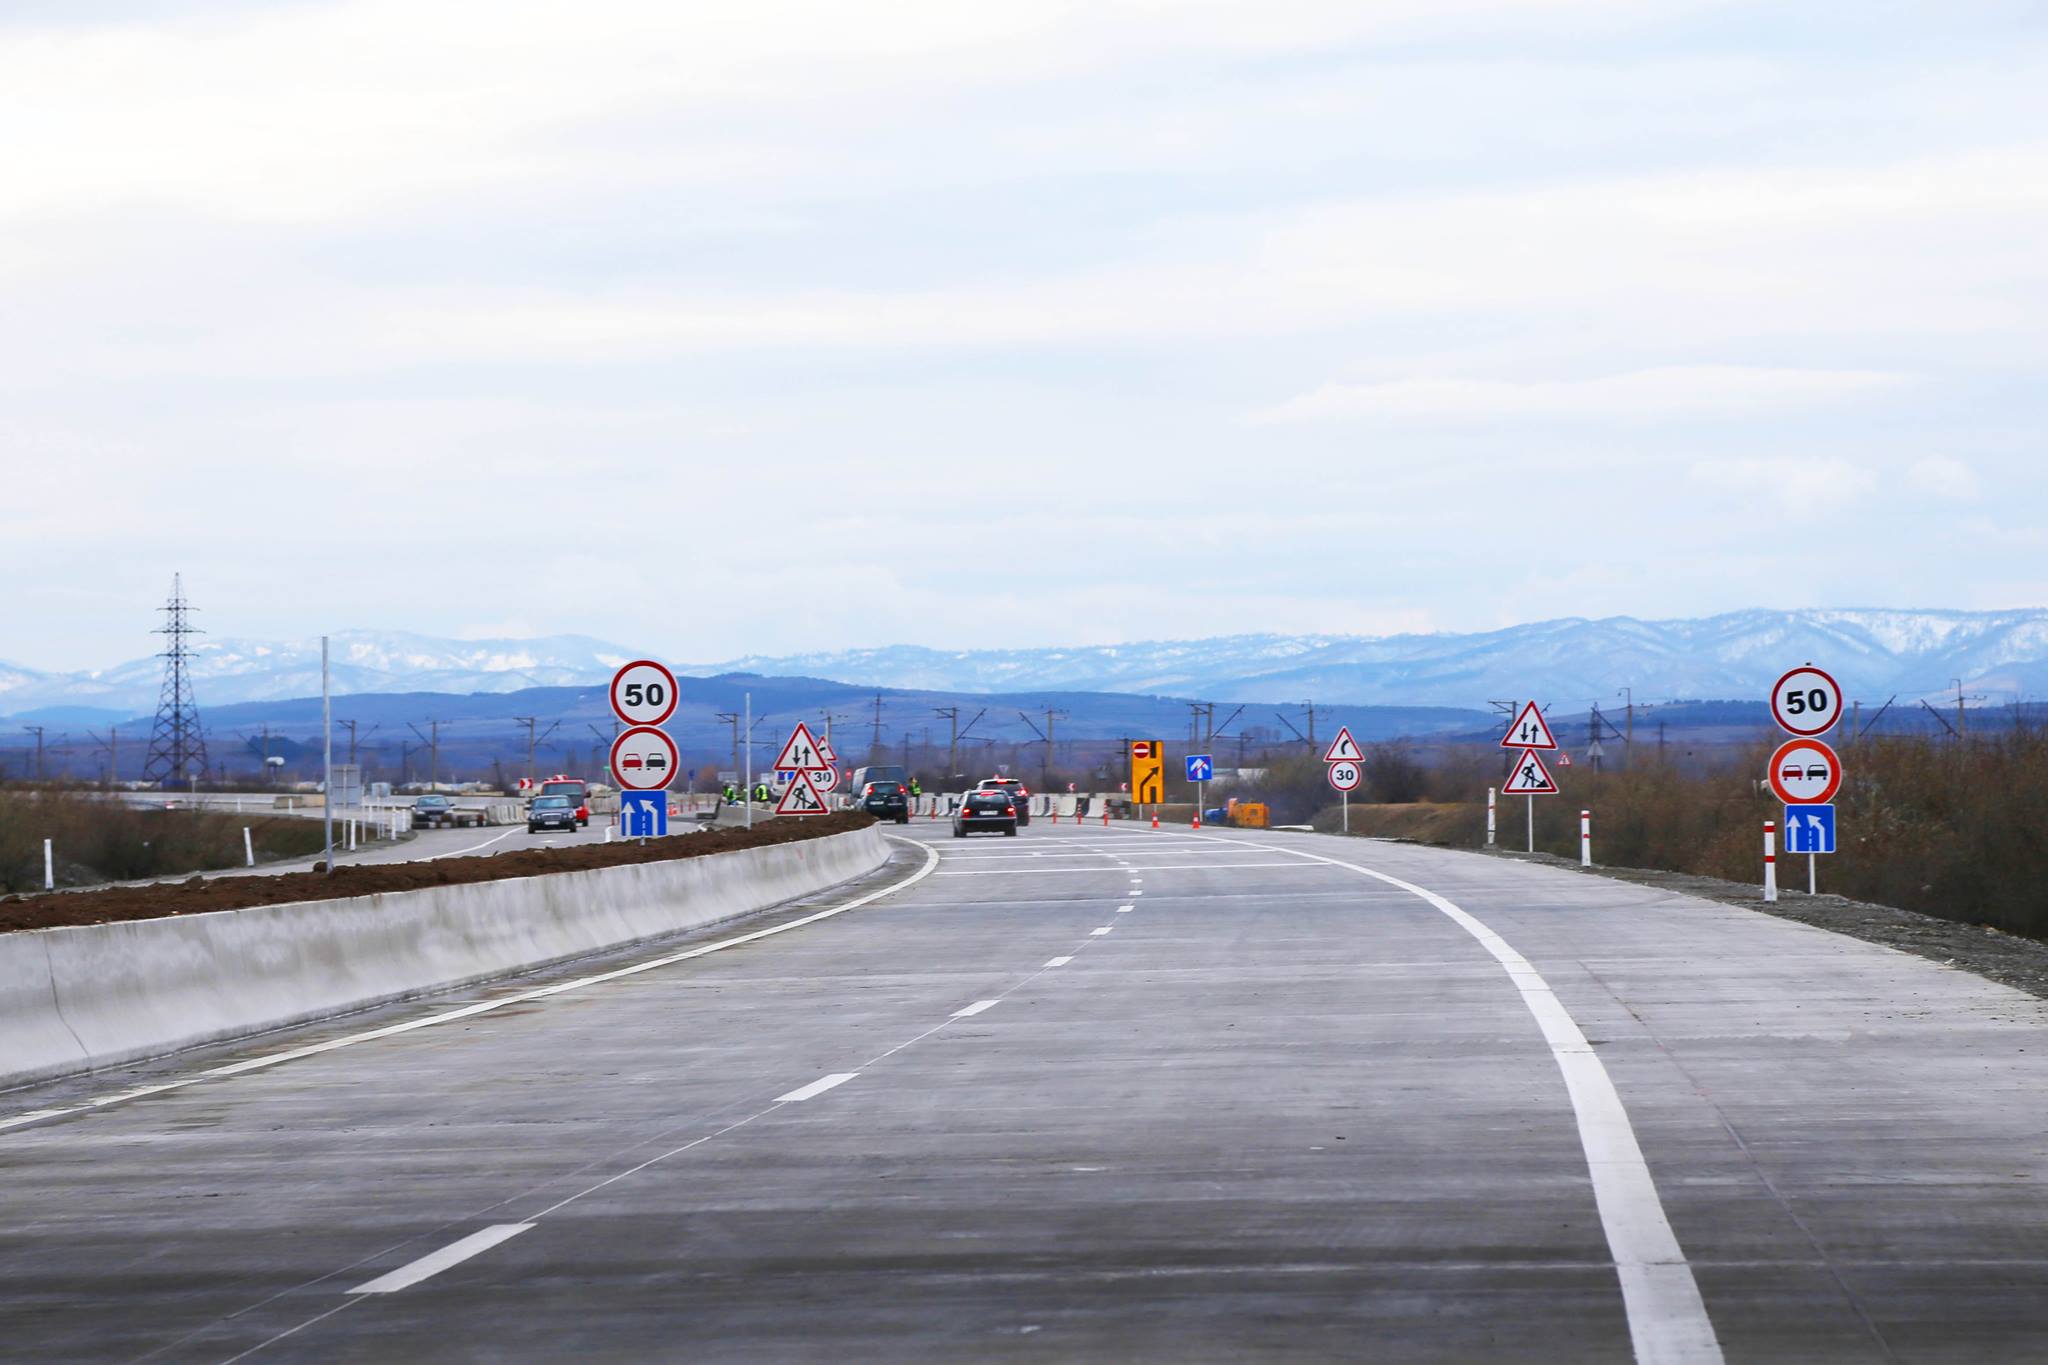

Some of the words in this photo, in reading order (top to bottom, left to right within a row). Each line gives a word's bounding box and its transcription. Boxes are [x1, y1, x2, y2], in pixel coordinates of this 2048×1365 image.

[625, 683, 664, 706] 50
[1787, 689, 1827, 714] 50
[814, 772, 832, 782] 30
[1336, 770, 1354, 780] 30
